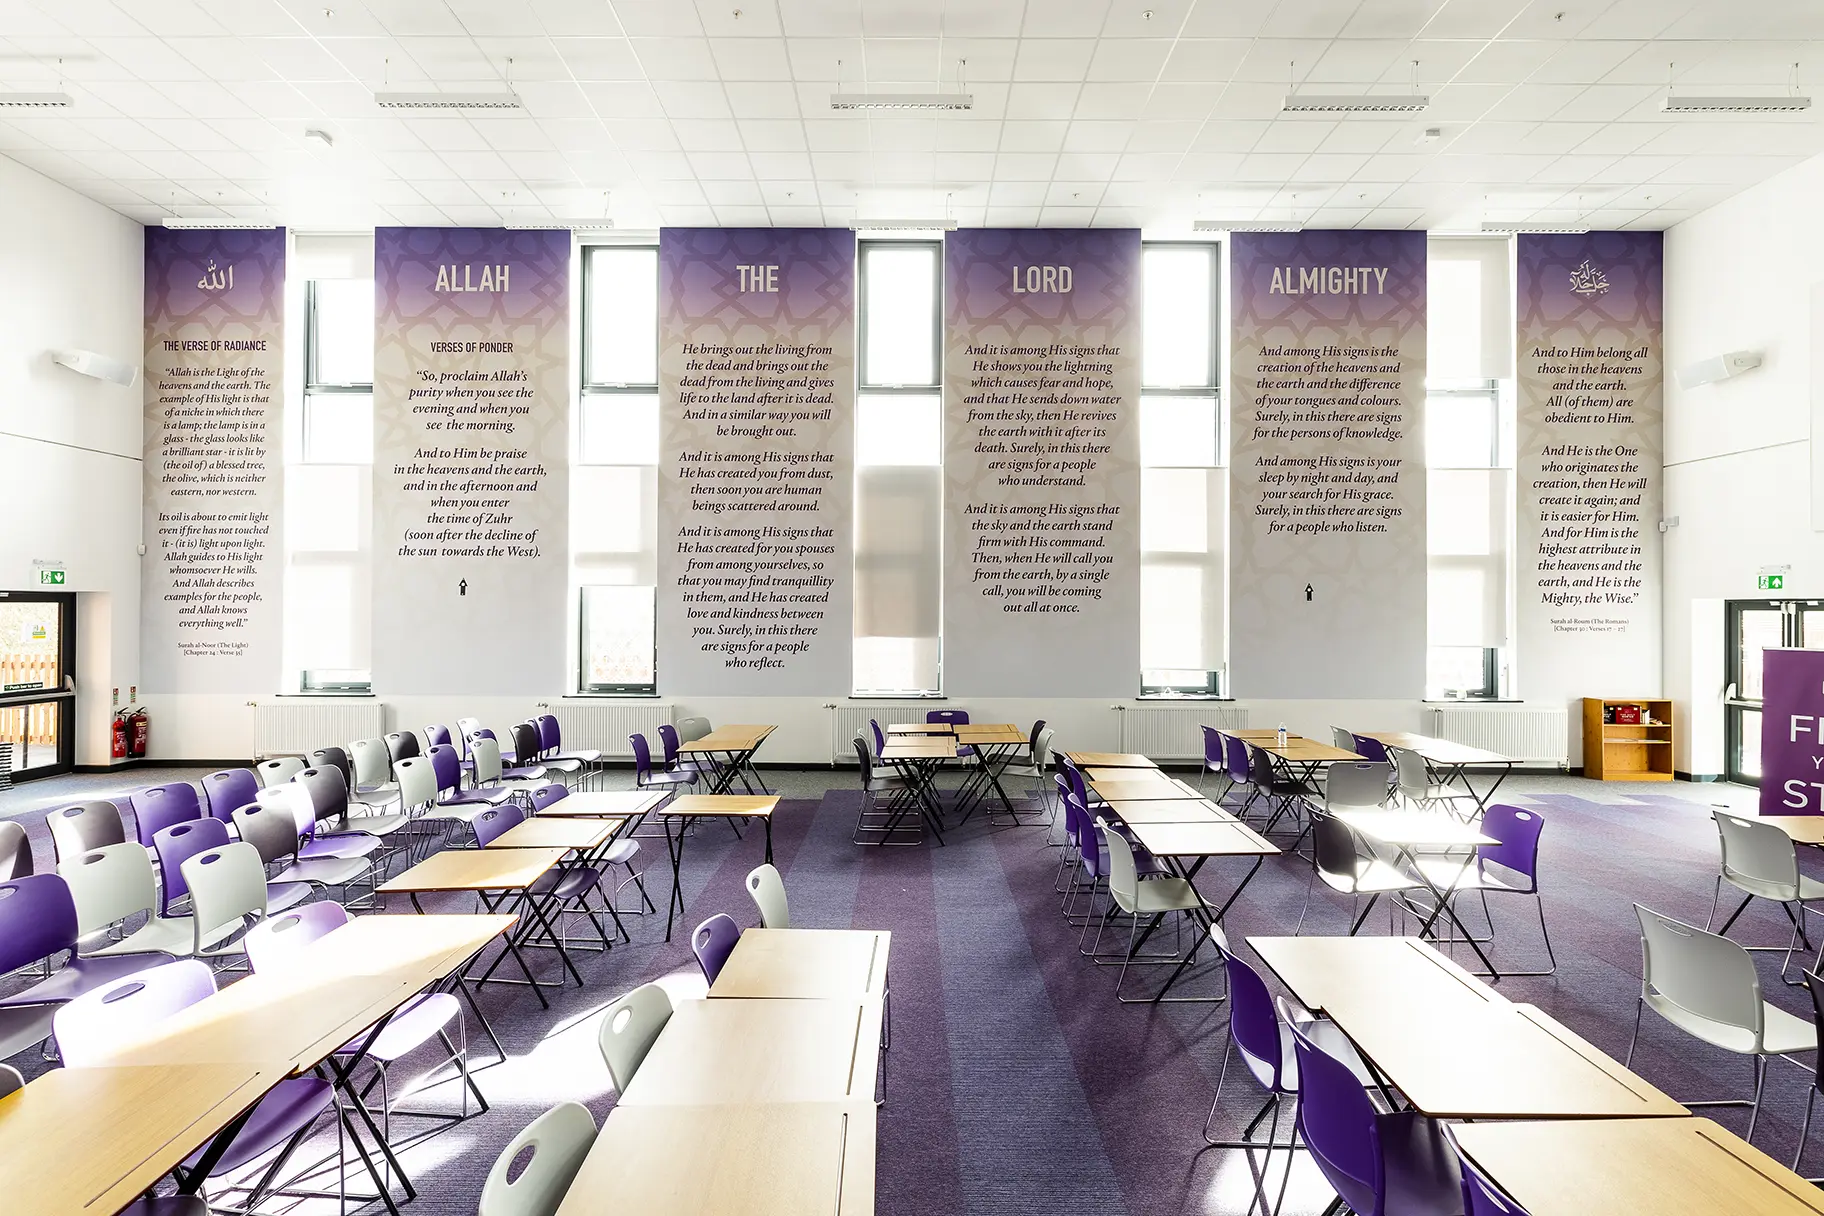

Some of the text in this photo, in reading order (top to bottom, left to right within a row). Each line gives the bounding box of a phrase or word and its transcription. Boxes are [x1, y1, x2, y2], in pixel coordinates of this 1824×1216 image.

[435, 265, 510, 292] ALLAH
[736, 264, 779, 293] THE
[1013, 266, 1072, 293] LORD
[1269, 266, 1388, 294] ALMIGHTY
[164, 340, 266, 351] THE VERSE OF RADIANCE
[431, 342, 513, 352] VERSES OF PONDER
[165, 367, 265, 379] “Allah is the Light of the
[417, 370, 527, 384] “So, proclaim Allah’s
[159, 394, 269, 406] example of His light is that
[964, 393, 1122, 404] and that He sends down water
[1255, 410, 1290, 425] Surely,
[1292, 411, 1303, 421] in
[1305, 410, 1326, 422] this
[1327, 410, 1356, 422] there
[1376, 412, 1402, 426] signs
[1545, 412, 1634, 423] obedient to Him.
[446, 419, 464, 430] the
[466, 420, 515, 434] morning.
[716, 425, 796, 440] be brought out.
[1252, 426, 1403, 442] for the persons of knowledge.
[414, 447, 527, 462] And to Him be praise
[1542, 445, 1638, 456] And He is the One
[403, 480, 538, 494] and in the afternoon and
[691, 483, 715, 494] then
[742, 487, 763, 498] you
[784, 484, 822, 494] human
[1539, 494, 1641, 508] create it again; and
[1267, 520, 1286, 534] for
[1295, 521, 1330, 535] people
[1332, 521, 1354, 532] who
[1355, 521, 1387, 532] listen.
[976, 535, 1105, 550] firm with His command.
[1538, 543, 1641, 557] highest attribute in
[164, 552, 187, 561] Allah
[187, 552, 215, 564] guides
[227, 552, 242, 561] His
[243, 552, 263, 564] light
[398, 545, 416, 556] the
[442, 545, 484, 556] towards
[486, 545, 504, 556] the
[507, 546, 540, 558] West).
[678, 574, 834, 589] that you may find tranquillity
[982, 584, 1102, 600] call, you will be coming
[1541, 592, 1639, 607] Mighty, the Wise.”
[687, 607, 823, 619] love and kindness between
[179, 618, 248, 630] everything well.”
[725, 656, 785, 671] who reflect.
